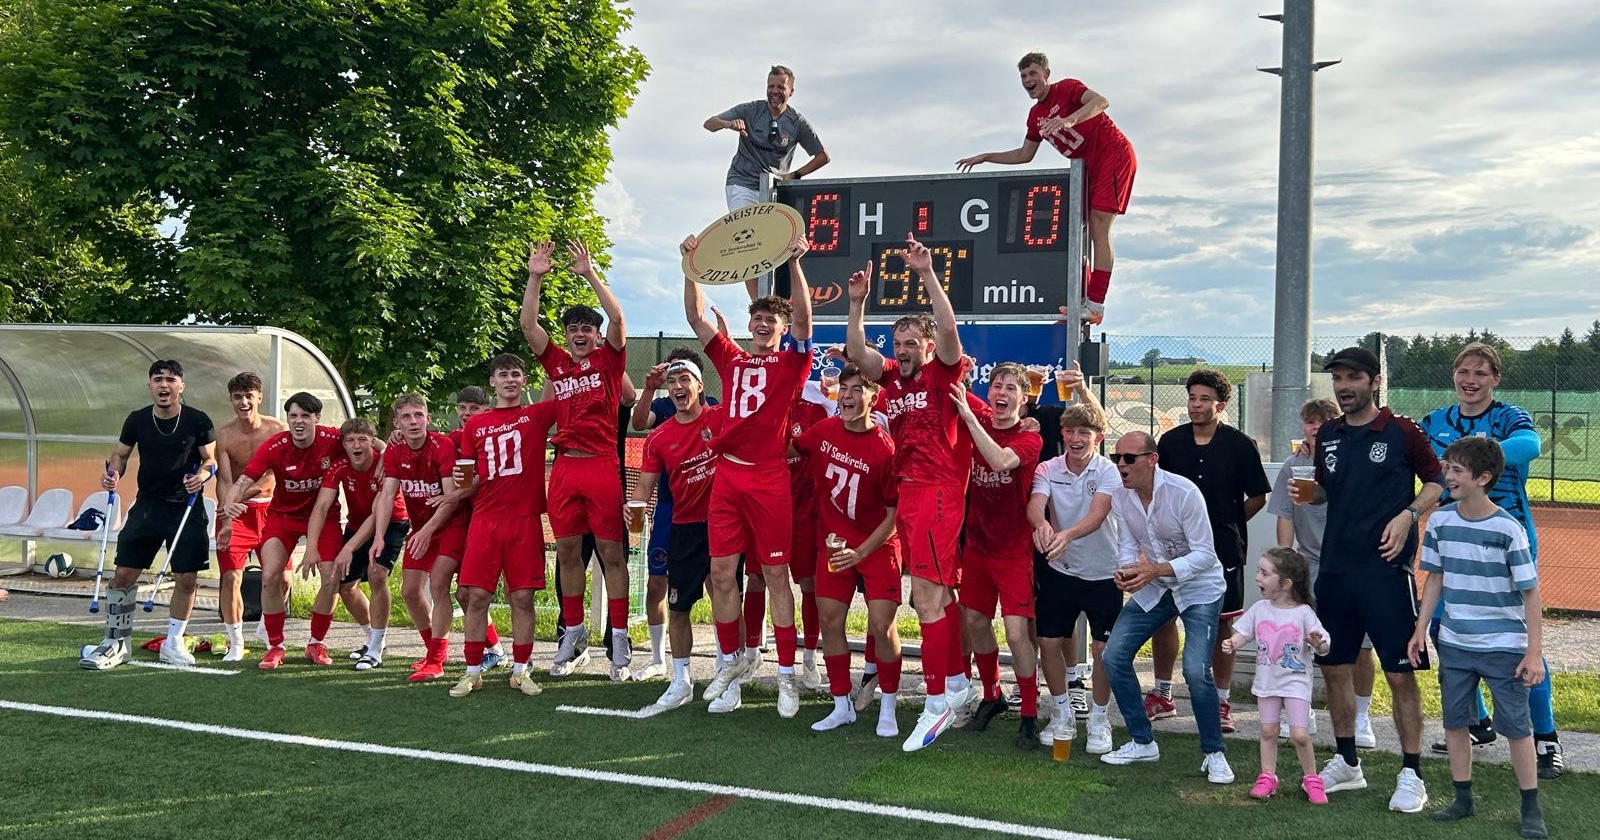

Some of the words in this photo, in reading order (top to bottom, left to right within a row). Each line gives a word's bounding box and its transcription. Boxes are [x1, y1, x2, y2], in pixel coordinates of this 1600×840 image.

[723, 204, 775, 225] MEISTER
[808, 194, 839, 250] 6
[858, 202, 884, 236] H
[960, 198, 990, 233] G
[1023, 184, 1062, 246] 0
[983, 279, 1044, 303] min.
[552, 372, 602, 395] Dihag
[729, 366, 767, 419] 18
[475, 427, 487, 437] SV
[820, 440, 833, 454] SV
[484, 429, 523, 481] 10
[825, 462, 861, 520] 21
